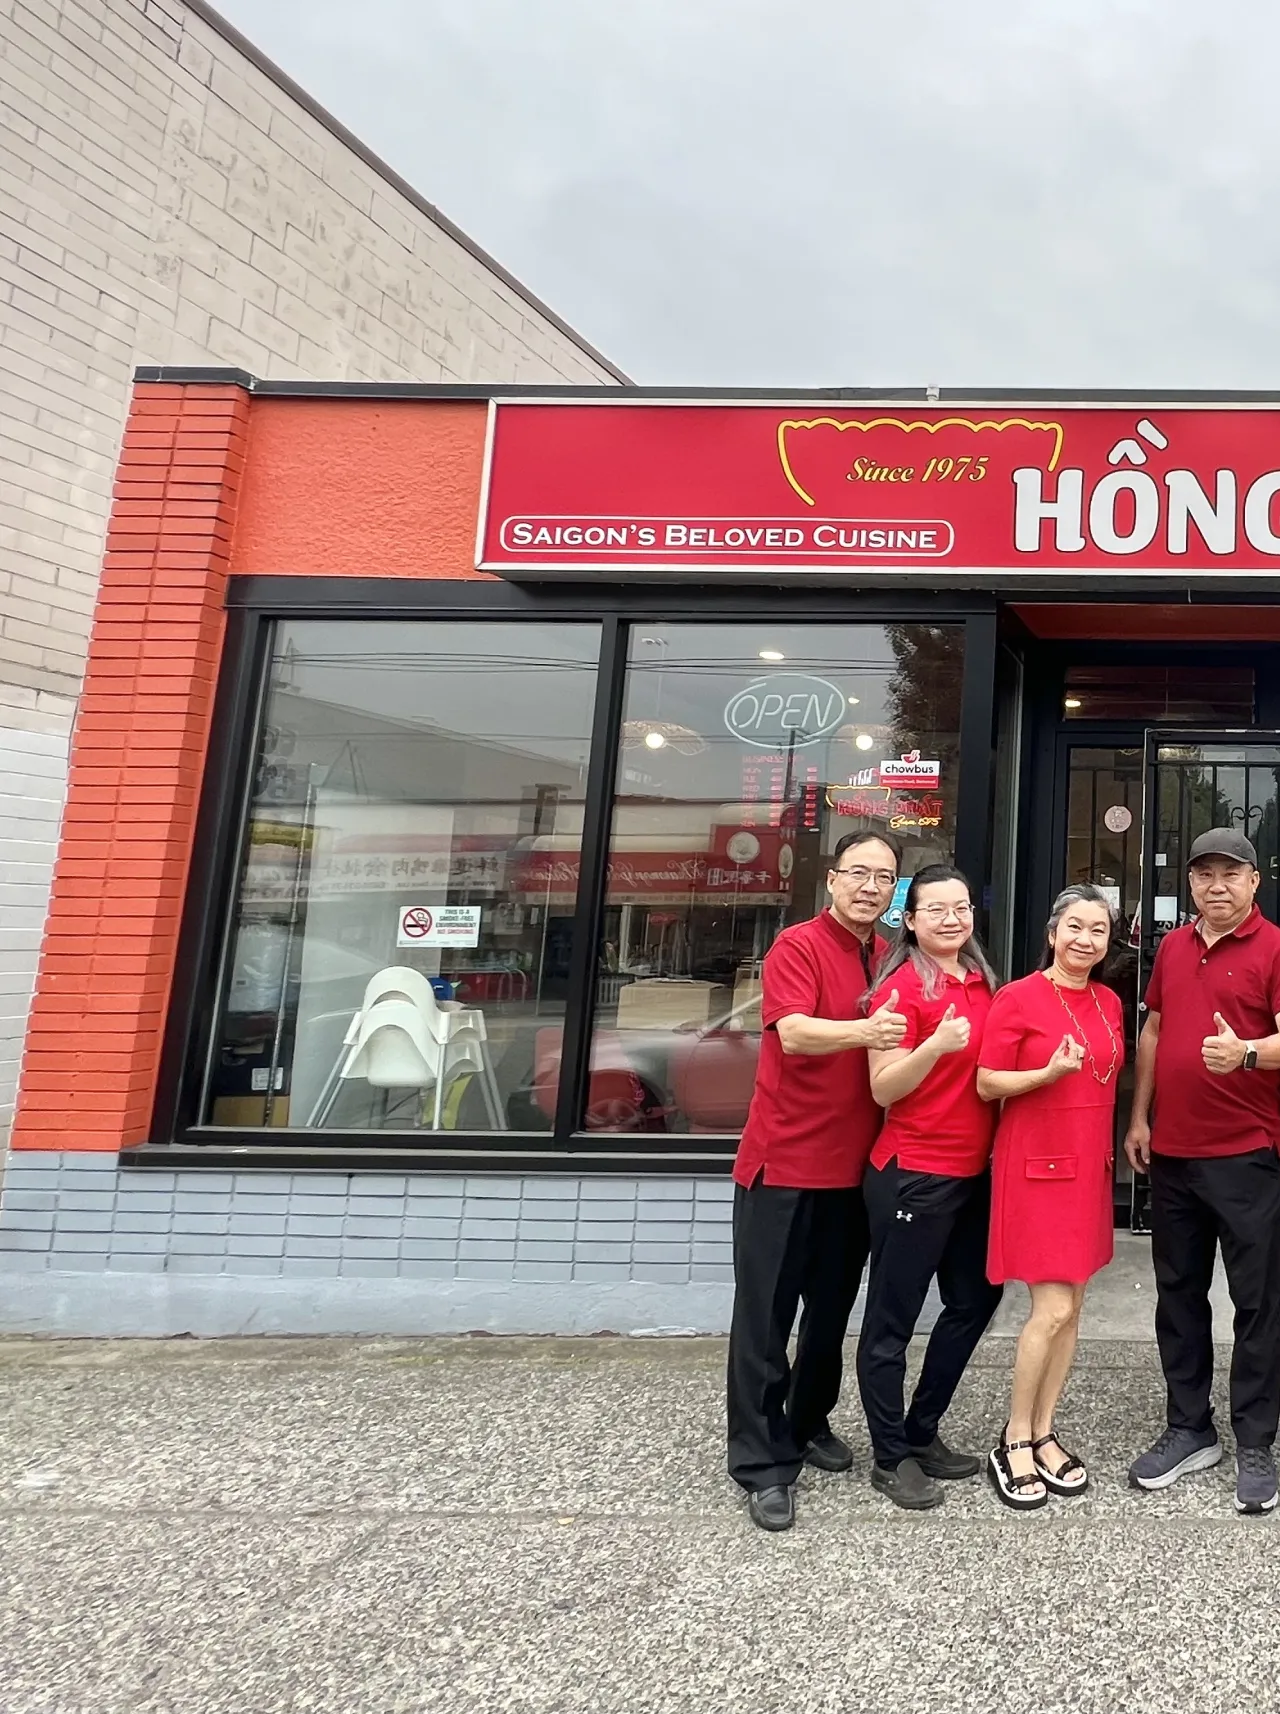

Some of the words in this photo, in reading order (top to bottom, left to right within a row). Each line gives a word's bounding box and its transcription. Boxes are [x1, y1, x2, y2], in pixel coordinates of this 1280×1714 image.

[845, 456, 915, 484] Since
[920, 455, 989, 484] 1975
[511, 522, 656, 548] SAIGON'S
[664, 524, 804, 549] BELOVED
[812, 526, 937, 549] CUISINE
[731, 693, 835, 730] OPEN
[885, 764, 934, 774] chowbus
